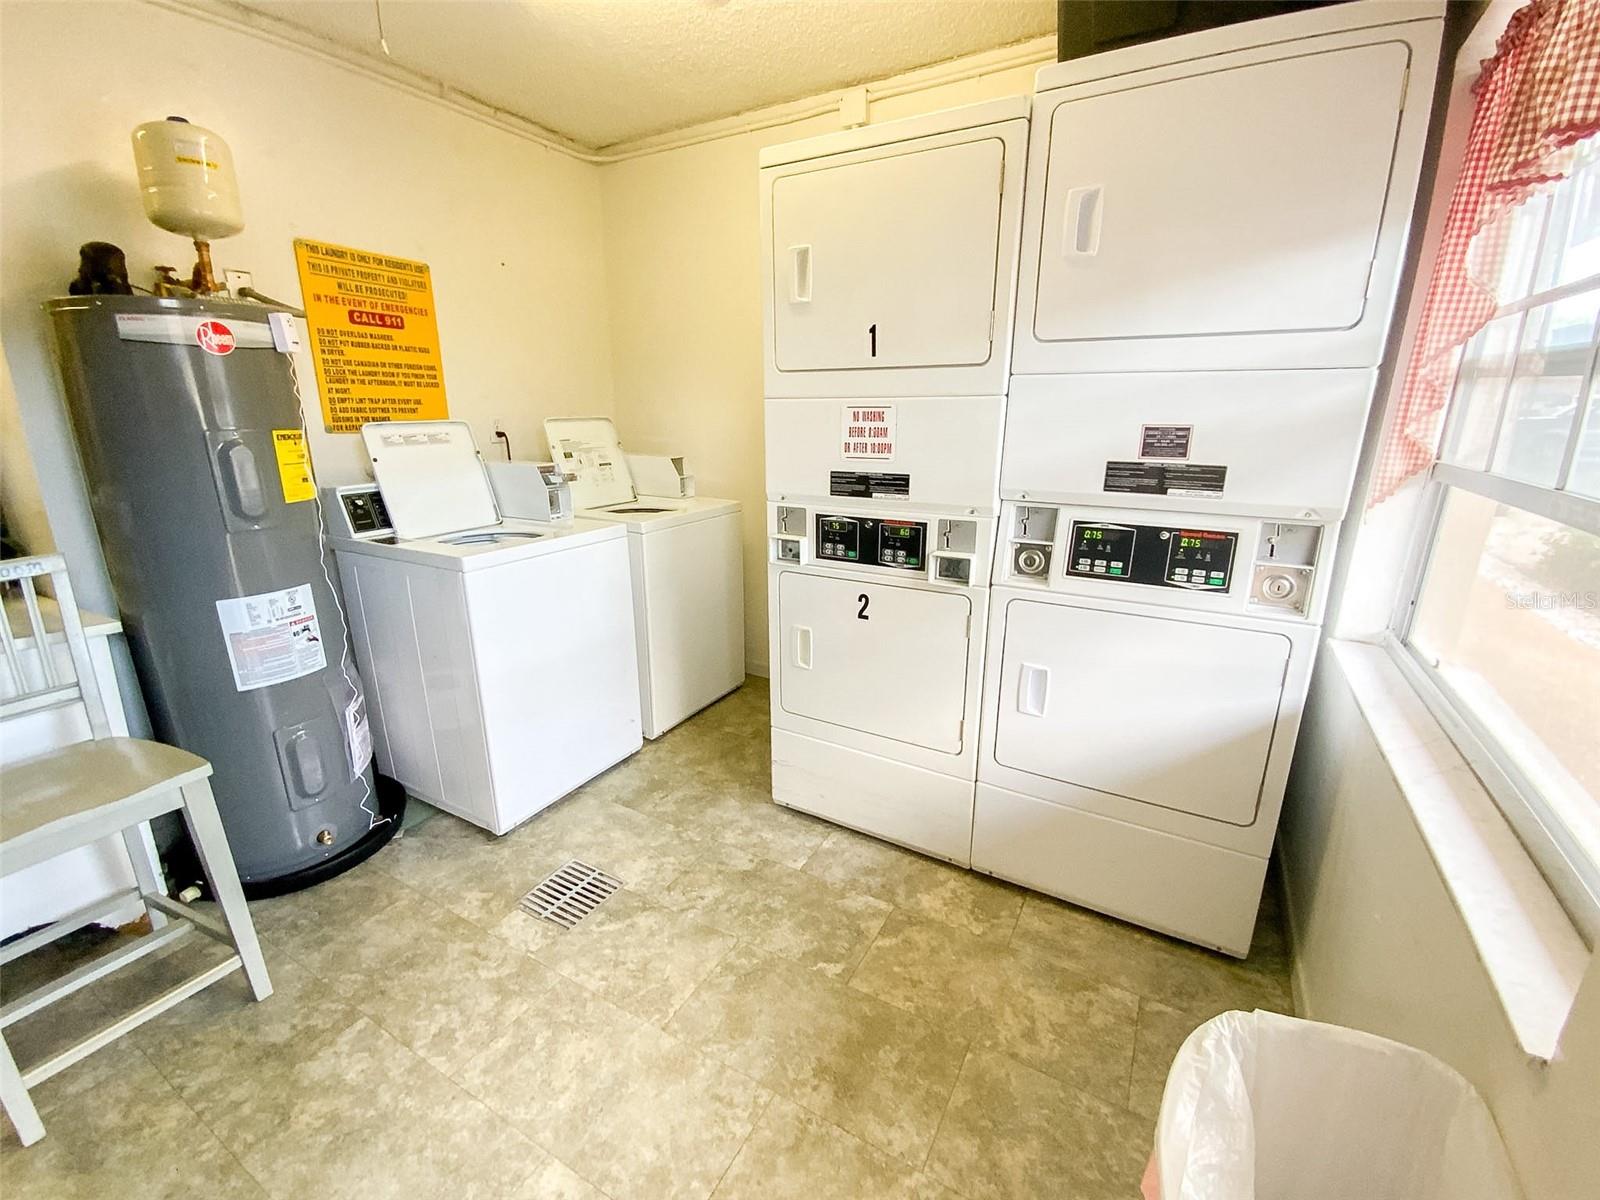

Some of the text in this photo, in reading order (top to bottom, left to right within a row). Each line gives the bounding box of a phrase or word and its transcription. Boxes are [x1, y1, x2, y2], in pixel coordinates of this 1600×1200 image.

[306, 244, 320, 254] THIS
[320, 246, 348, 258] LAUNDRY
[357, 254, 371, 264] ONLY
[373, 256, 384, 266] FOR
[307, 261, 322, 272] THIS
[331, 265, 355, 278] PRIVATE
[356, 269, 385, 284] PROPERTY
[387, 275, 398, 284] AND
[337, 281, 352, 292] WILL
[355, 283, 362, 293] BE
[313, 293, 428, 316] IN THE EVENT OF EMERGENCIES
[353, 312, 402, 327] CALL 911
[200, 321, 233, 349] Rheem
[317, 327, 325, 335] DO
[326, 328, 338, 336] NOT
[339, 329, 368, 339] OVERLOAD
[319, 337, 326, 345] DO
[327, 338, 339, 347] NOT
[869, 323, 877, 357] 1
[330, 358, 341, 366] NOT
[342, 359, 353, 367] USE
[354, 360, 379, 368] CANADIAN
[332, 368, 346, 376] LOCK
[359, 370, 380, 378] LAUNDRY
[325, 377, 349, 385] LAUNDRY
[357, 378, 367, 386] THE
[367, 397, 380, 405] TRAP
[338, 406, 349, 414] ADD
[853, 411, 885, 423] NO WASHING
[848, 426, 867, 438] BEFORE
[844, 442, 893, 455] OR AFTER 10:00PM
[857, 593, 870, 620] 2
